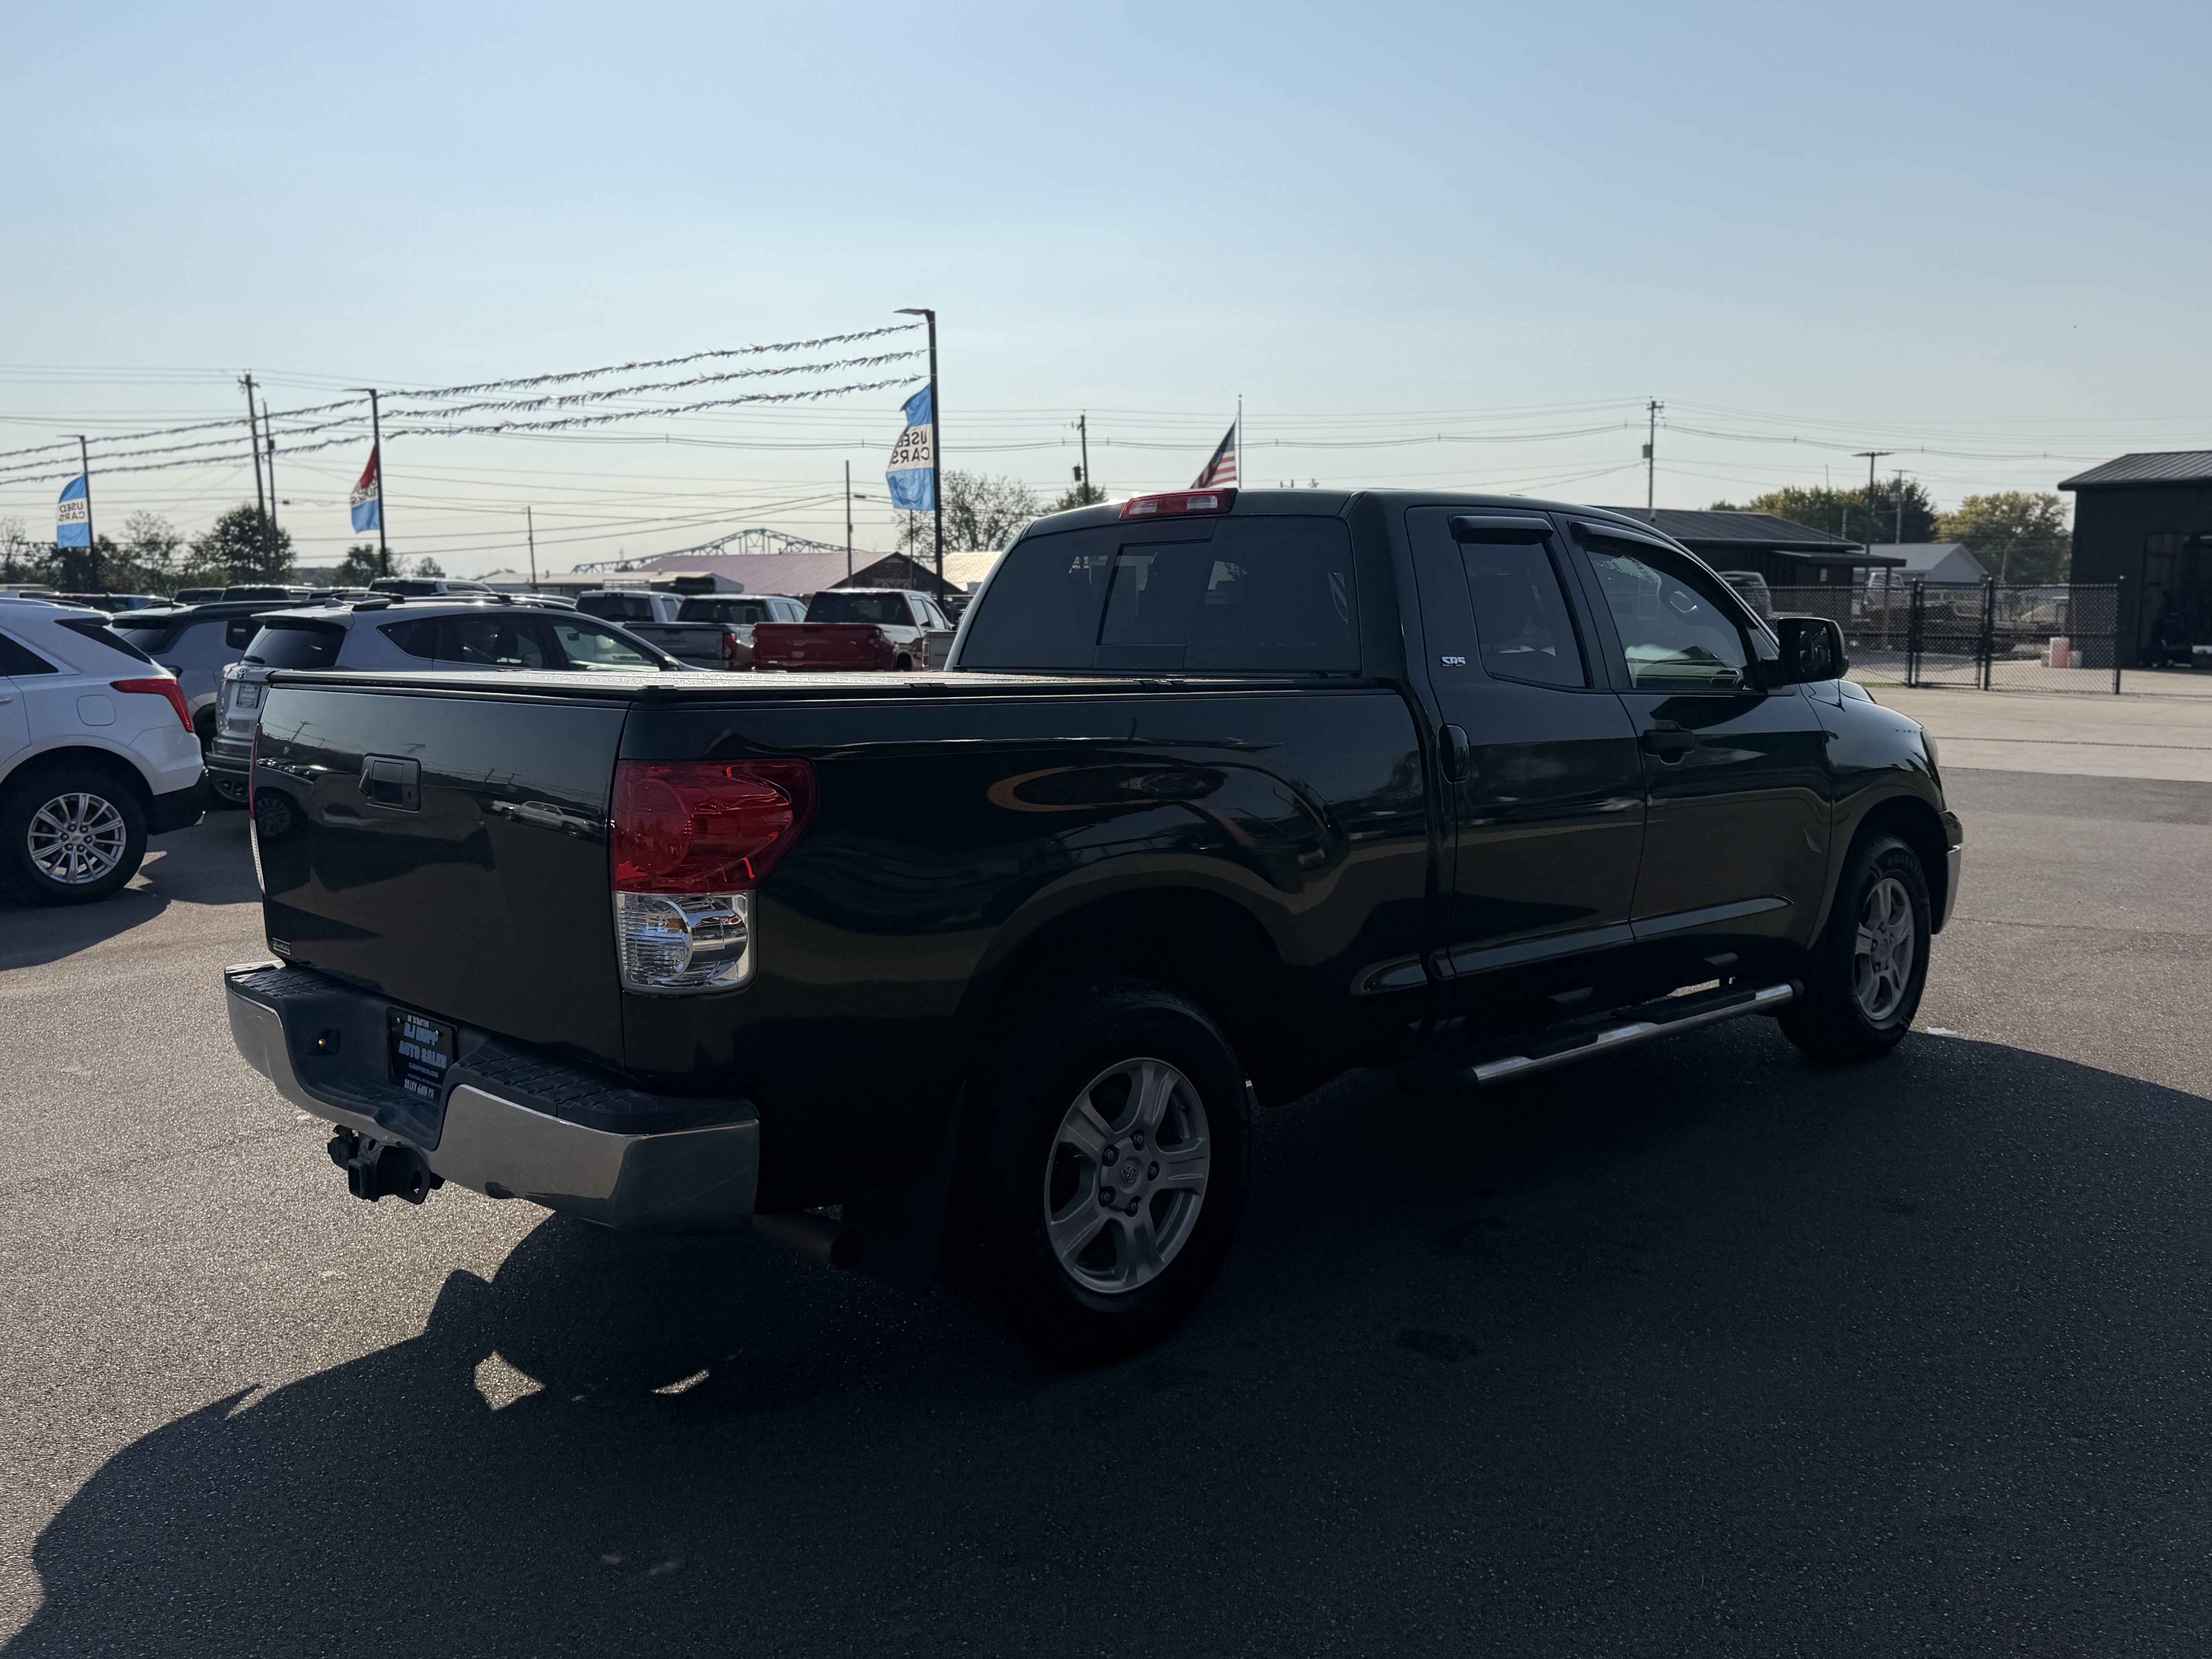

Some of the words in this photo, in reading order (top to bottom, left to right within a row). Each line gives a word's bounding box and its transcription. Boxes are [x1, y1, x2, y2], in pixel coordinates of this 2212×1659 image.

[1441, 656, 1466, 665] SR5
[398, 1040, 421, 1060] AUTO
[421, 1048, 447, 1069] SALES
